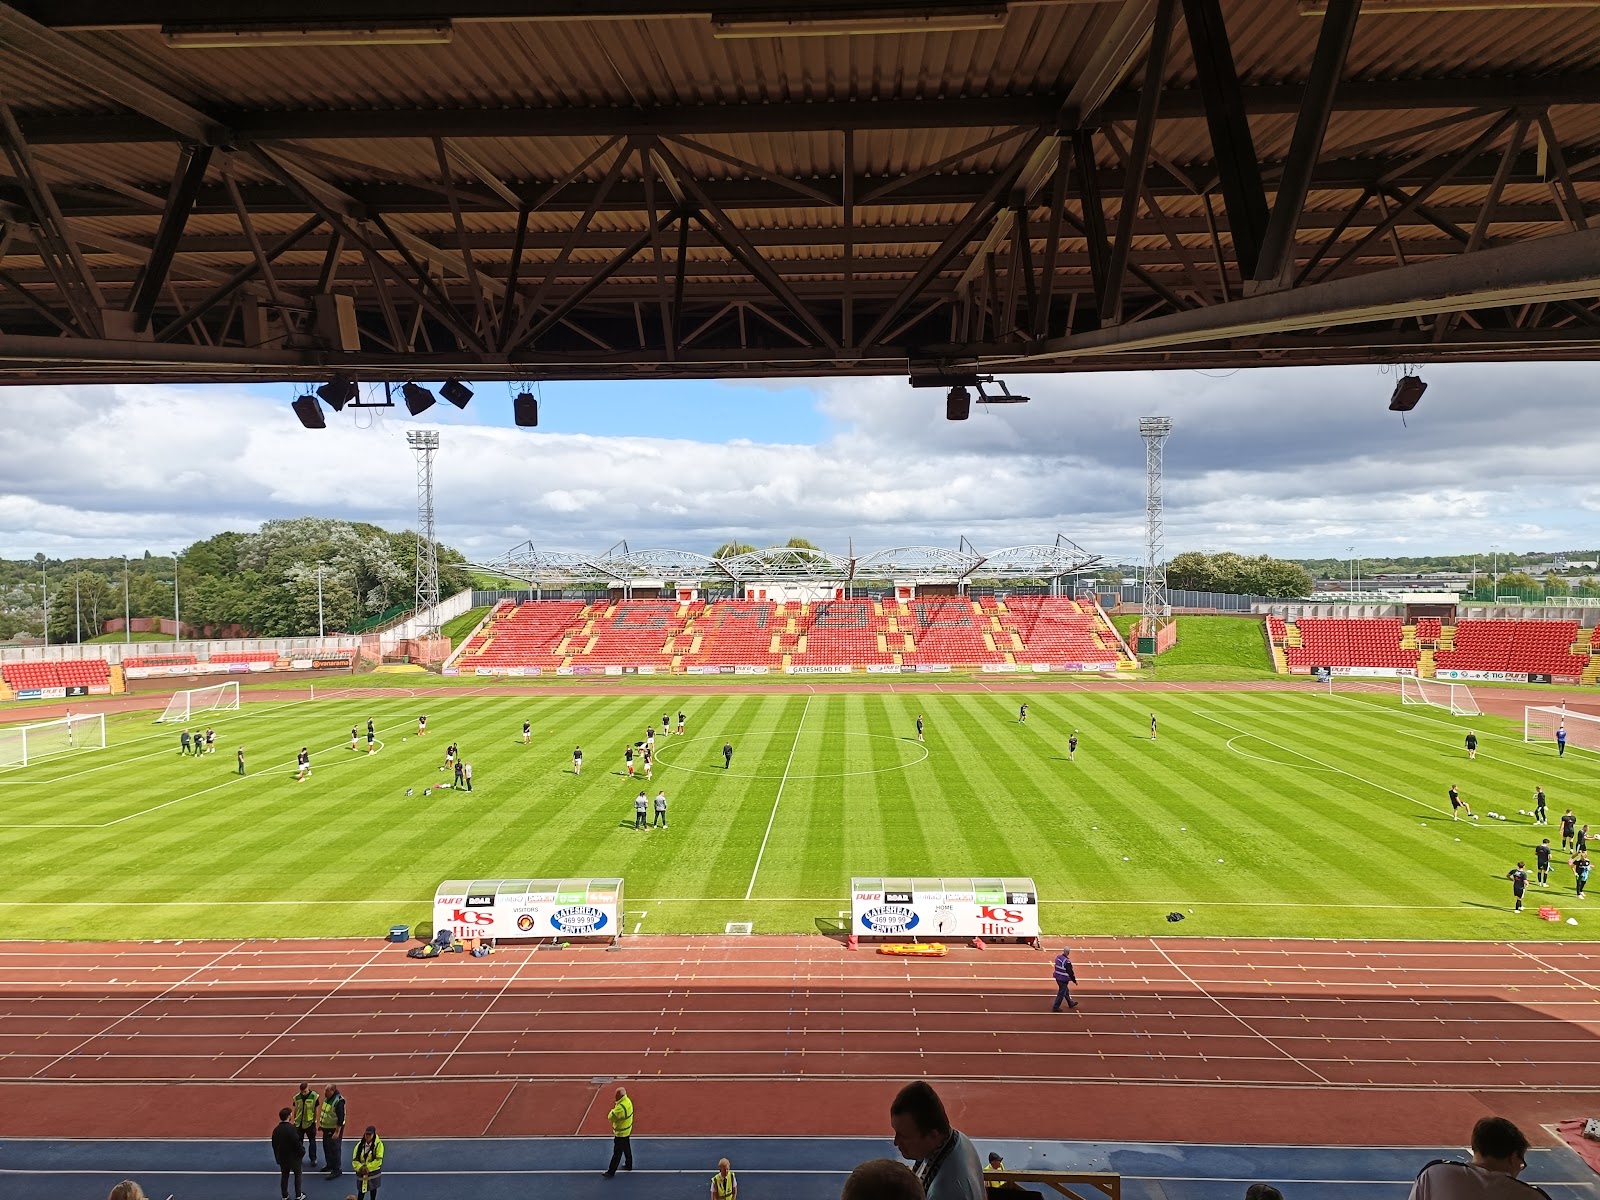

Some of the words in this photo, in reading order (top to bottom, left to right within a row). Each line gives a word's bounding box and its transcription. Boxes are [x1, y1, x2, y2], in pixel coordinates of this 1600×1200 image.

[437, 897, 463, 905] pure
[855, 893, 881, 901] pure
[447, 909, 494, 926] JCS
[553, 906, 603, 921] GATESHEAD
[865, 905, 915, 920] GATESHEAD
[976, 906, 1024, 923] JCS
[453, 926, 485, 937] Hire
[559, 924, 597, 934] CENTRAL
[870, 923, 908, 934] CENTRAL
[981, 923, 1015, 935] Hire
